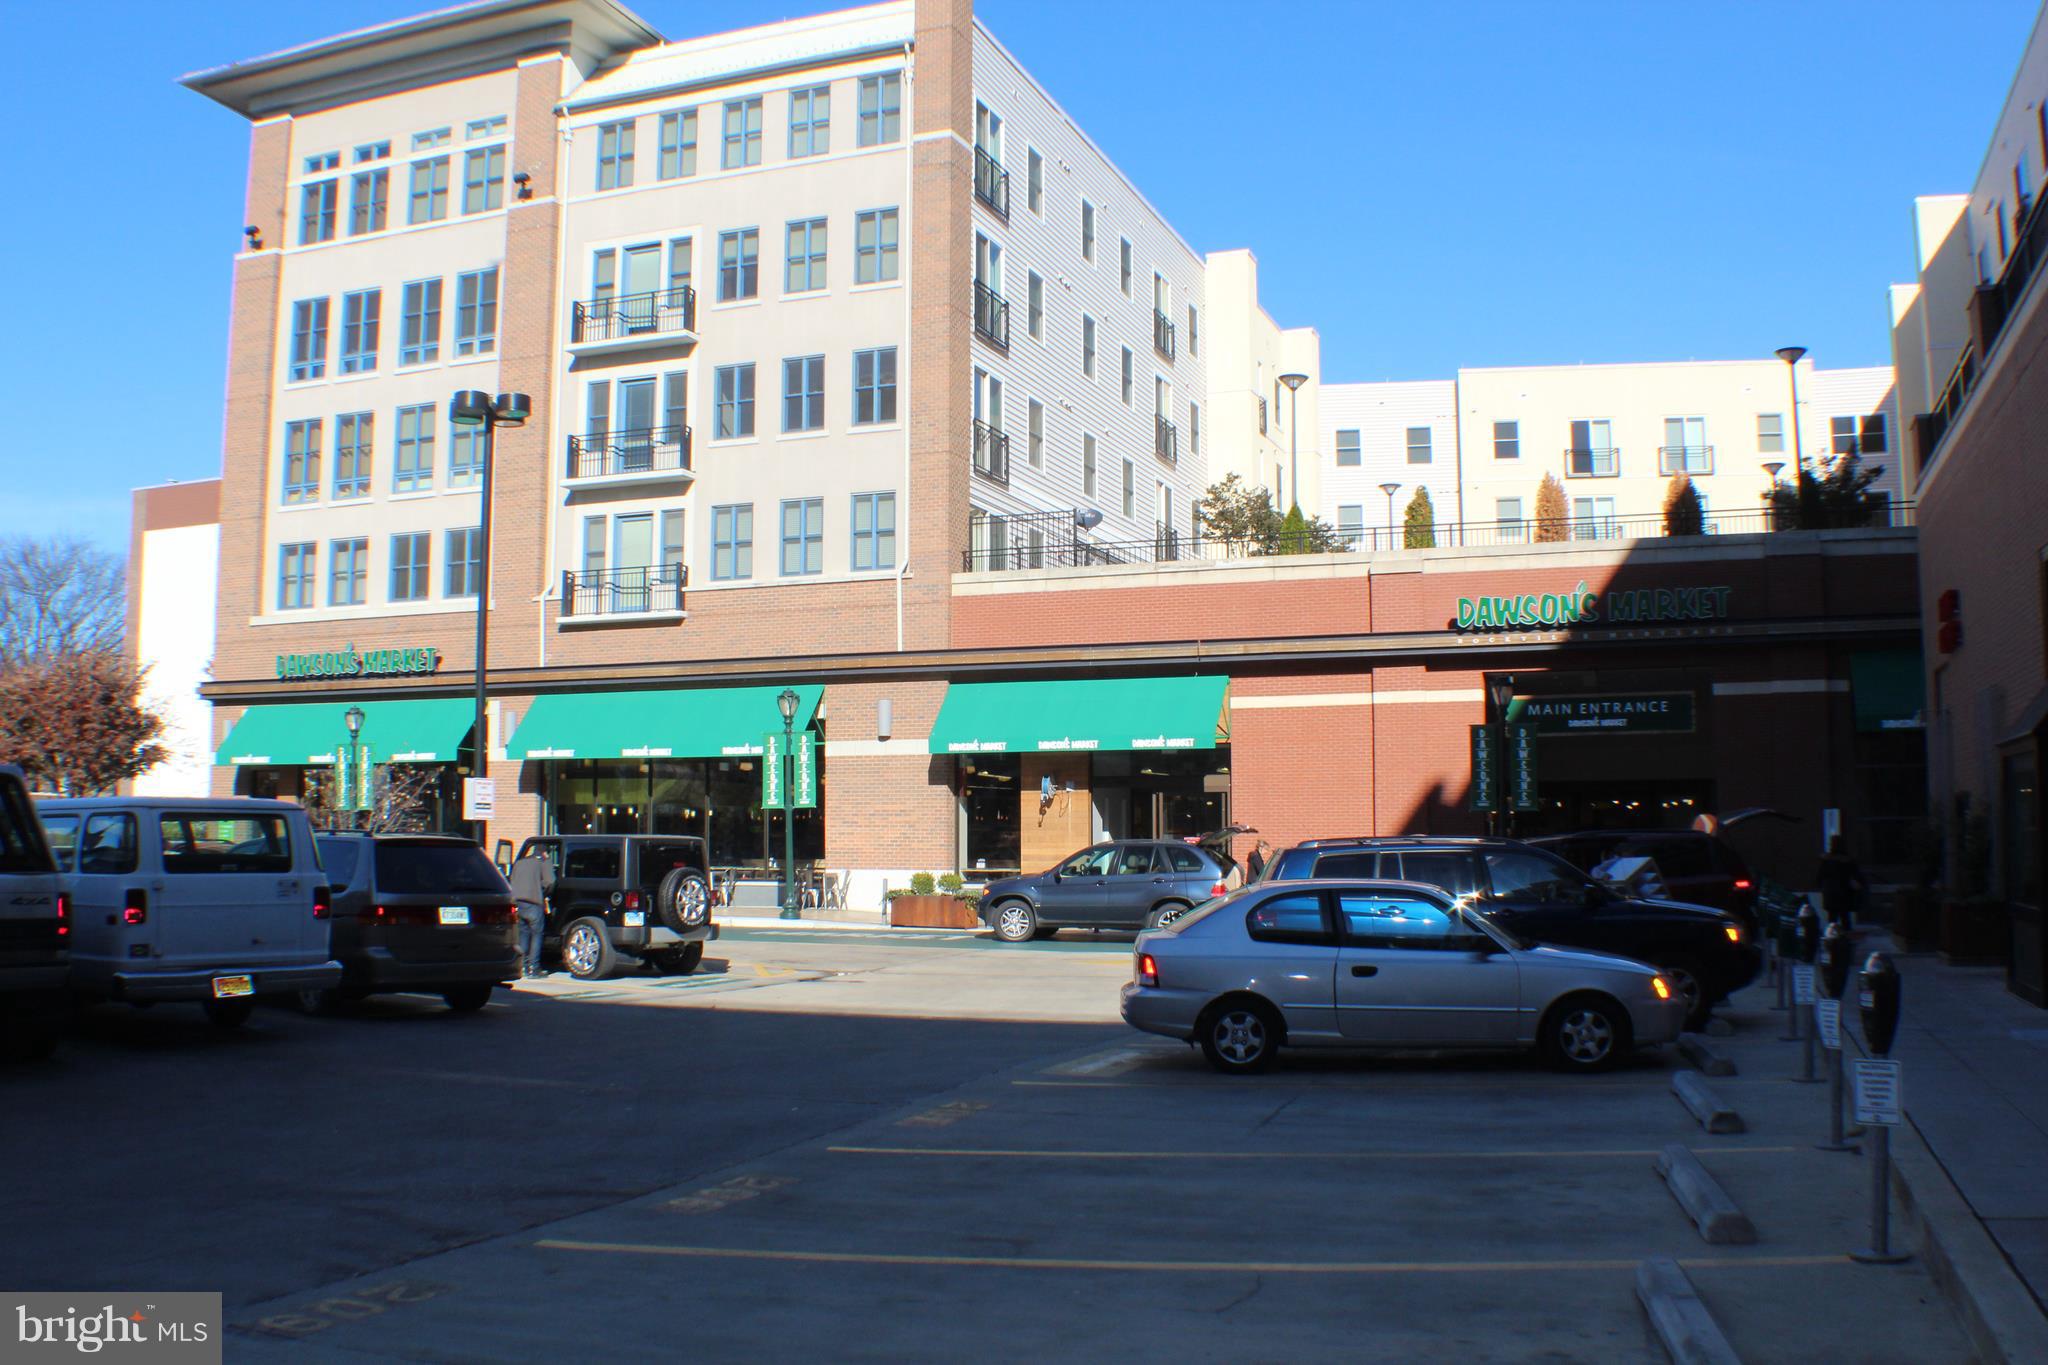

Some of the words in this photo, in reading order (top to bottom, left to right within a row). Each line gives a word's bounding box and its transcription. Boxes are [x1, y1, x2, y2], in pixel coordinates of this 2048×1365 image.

[1455, 580, 1600, 628] DAWSON'S
[1608, 586, 1732, 622] MARKET
[362, 646, 438, 674] MARKET
[1527, 703, 1573, 716] MAIN
[1579, 701, 1670, 715] ENTRANCE
